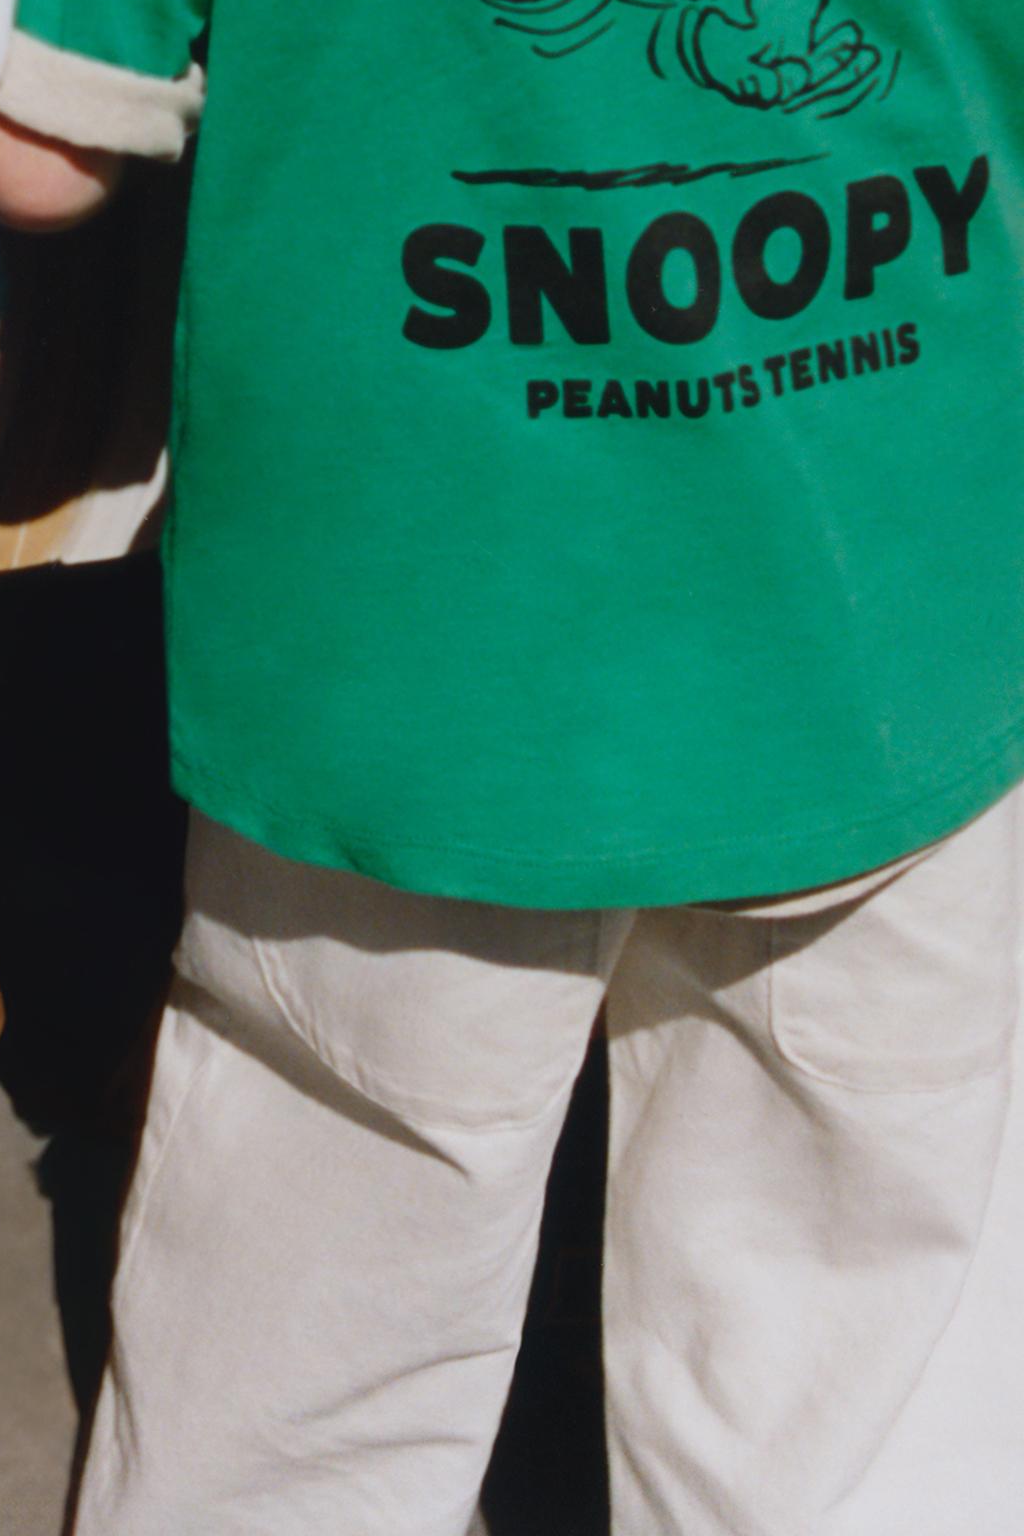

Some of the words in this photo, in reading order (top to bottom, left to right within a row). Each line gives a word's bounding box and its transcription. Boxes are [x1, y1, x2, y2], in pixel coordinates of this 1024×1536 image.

[401, 155, 990, 351] SNOOPY
[526, 364, 761, 420] PEANUTS
[763, 322, 920, 397] TENNIS
